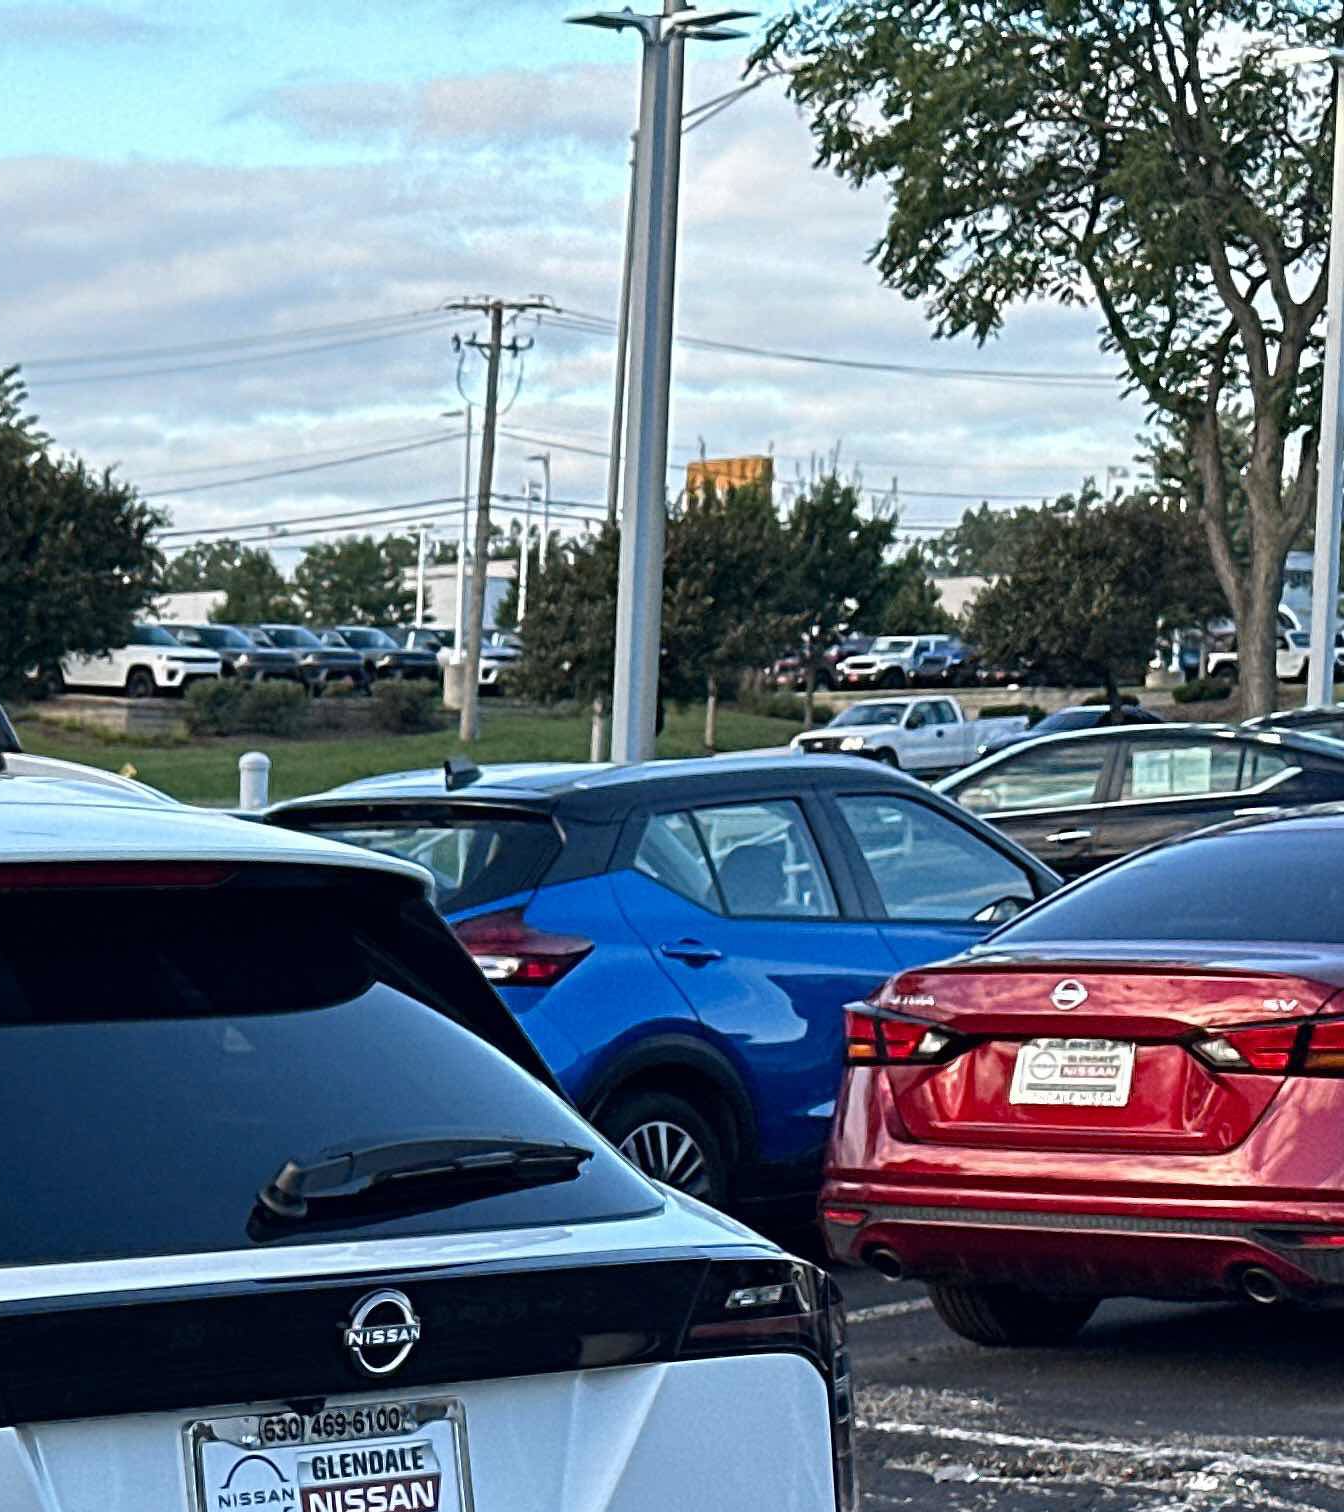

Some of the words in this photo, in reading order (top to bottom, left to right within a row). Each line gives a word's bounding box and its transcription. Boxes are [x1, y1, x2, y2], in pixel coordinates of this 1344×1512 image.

[1062, 1065, 1118, 1077] NISSAN
[347, 1327, 420, 1346] NISSAN
[258, 1415, 306, 1445] (630)
[311, 1406, 401, 1438] 469-6100
[311, 1446, 425, 1481] GLENDALE
[217, 1487, 296, 1510] NISSAN
